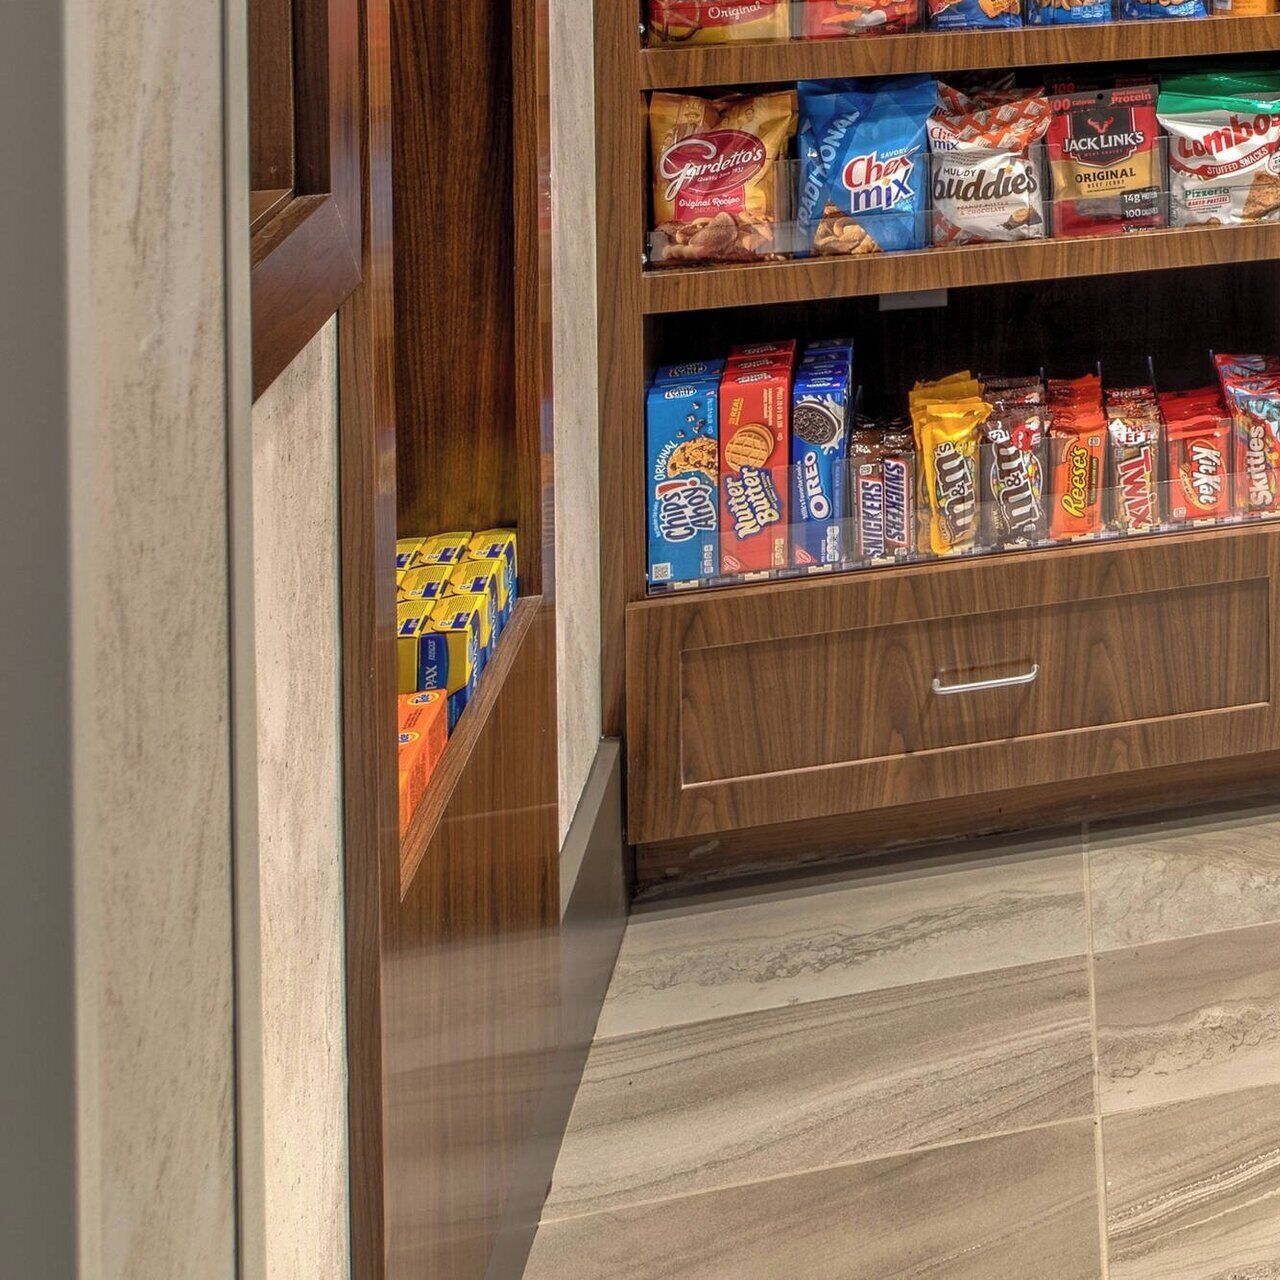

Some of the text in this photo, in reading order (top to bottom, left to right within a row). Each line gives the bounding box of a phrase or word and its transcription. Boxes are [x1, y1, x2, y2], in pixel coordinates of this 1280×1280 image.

[708, 1, 762, 20] Original
[1111, 93, 1151, 104] Protein
[934, 140, 959, 150] mix
[1063, 131, 1144, 153] JACK LINK'S
[660, 139, 762, 200] Gardetto's
[844, 156, 910, 188] Chex
[943, 167, 977, 177] MUDDY
[1075, 168, 1136, 183] ORIGINAL
[1207, 163, 1238, 175] STUFFED
[1240, 148, 1268, 167] SNACKS
[853, 172, 912, 211] mix
[933, 165, 1037, 201] buddies
[1185, 187, 1229, 198] Pizzeria
[679, 196, 741, 210] Original Recipe
[1125, 210, 1141, 218] 100
[654, 440, 679, 481] ORIGINAL
[1247, 425, 1273, 507] Skittles
[804, 452, 831, 519] OREO
[884, 459, 907, 544] SNICKERS
[1118, 448, 1153, 529] TWIX
[661, 492, 696, 541] Chips
[727, 467, 779, 539] Nutter Butter
[862, 482, 883, 558] SNICKERS
